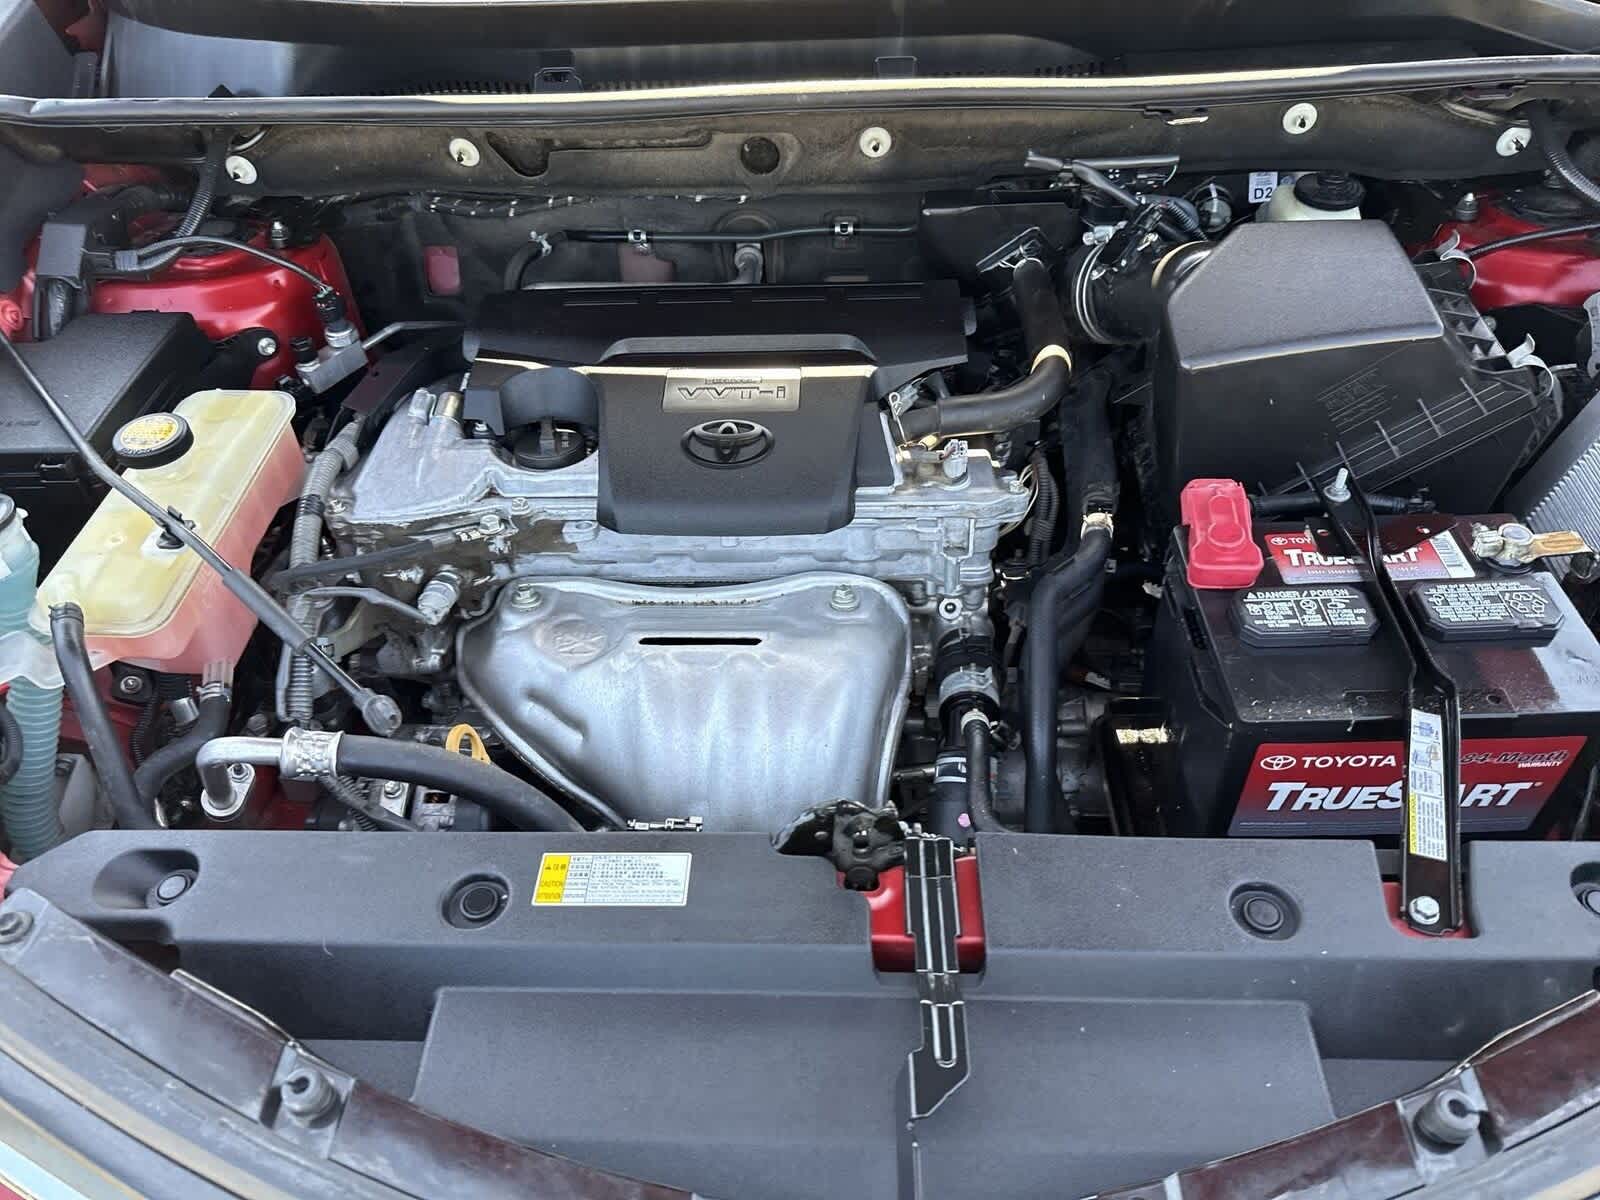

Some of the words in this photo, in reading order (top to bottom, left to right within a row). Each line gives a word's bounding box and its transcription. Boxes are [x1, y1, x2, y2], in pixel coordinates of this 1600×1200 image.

[1254, 187, 1273, 200] D2
[678, 386, 786, 400] VVT-i
[1257, 591, 1299, 599] DANGER
[1310, 589, 1349, 597] POISON
[1301, 755, 1397, 769] TOYOTA
[1518, 761, 1563, 769] WARRANTY
